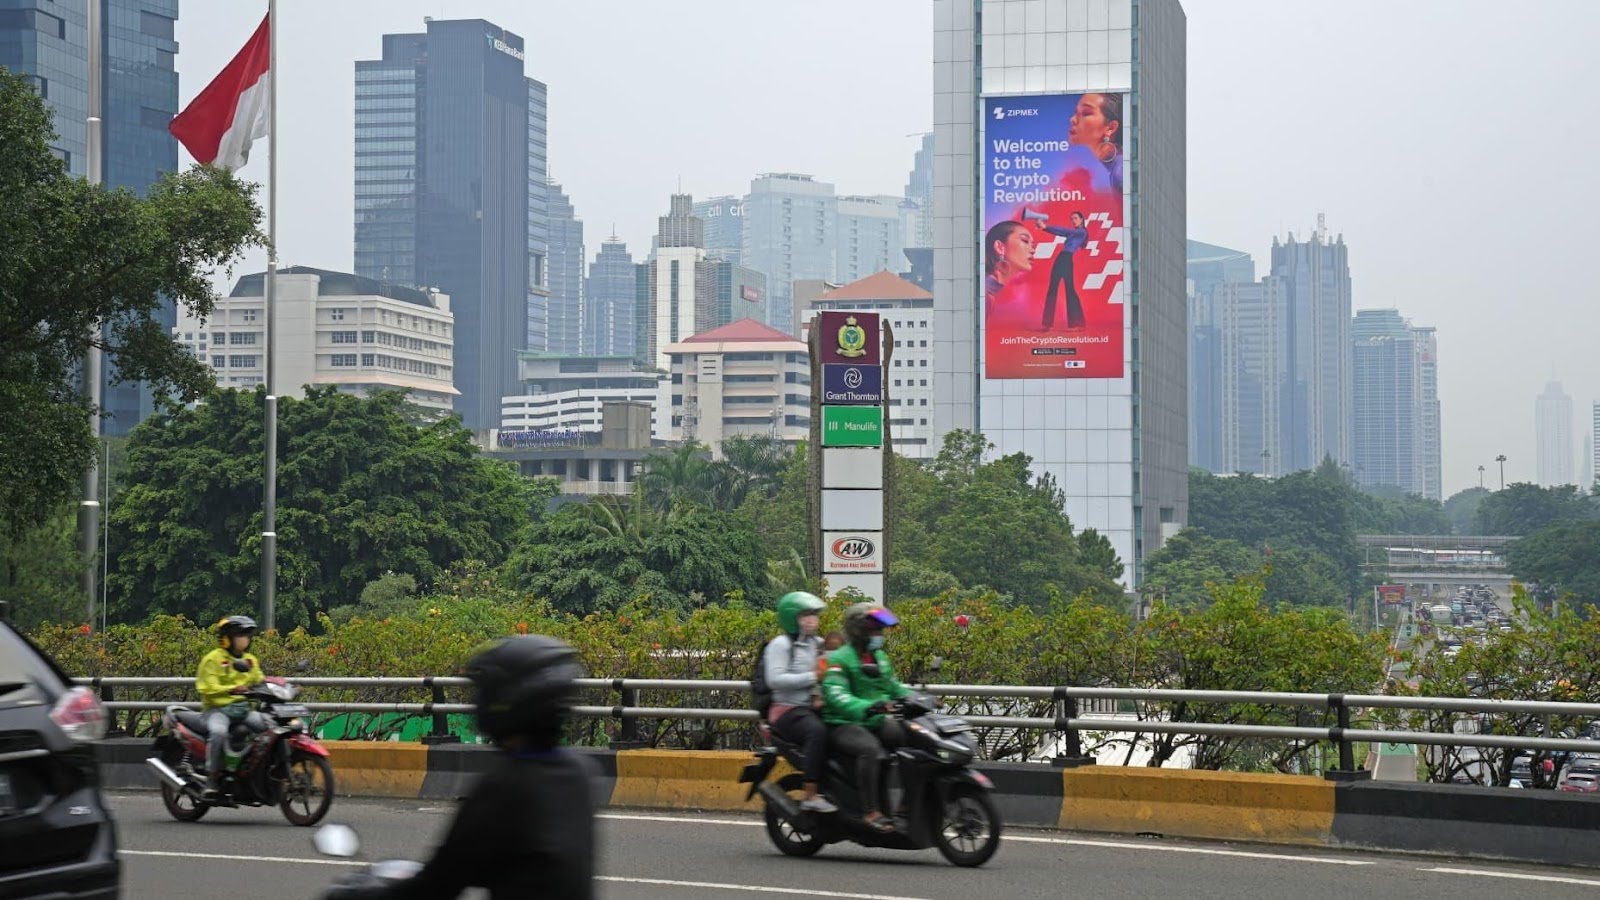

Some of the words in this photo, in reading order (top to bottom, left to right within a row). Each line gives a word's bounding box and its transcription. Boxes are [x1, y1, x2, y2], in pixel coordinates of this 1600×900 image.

[1007, 108, 1039, 117] ZIPMEX
[993, 139, 1069, 153] Welcome
[993, 156, 1010, 170] to
[1014, 155, 1041, 169] the
[993, 172, 1050, 189] Crypto
[993, 187, 1086, 203] Revolution.
[1000, 336, 1109, 346] JoinTheCryptoRevolution.id
[826, 391, 847, 401] Grant
[847, 391, 879, 401] Thornton
[844, 421, 878, 431] Manulife
